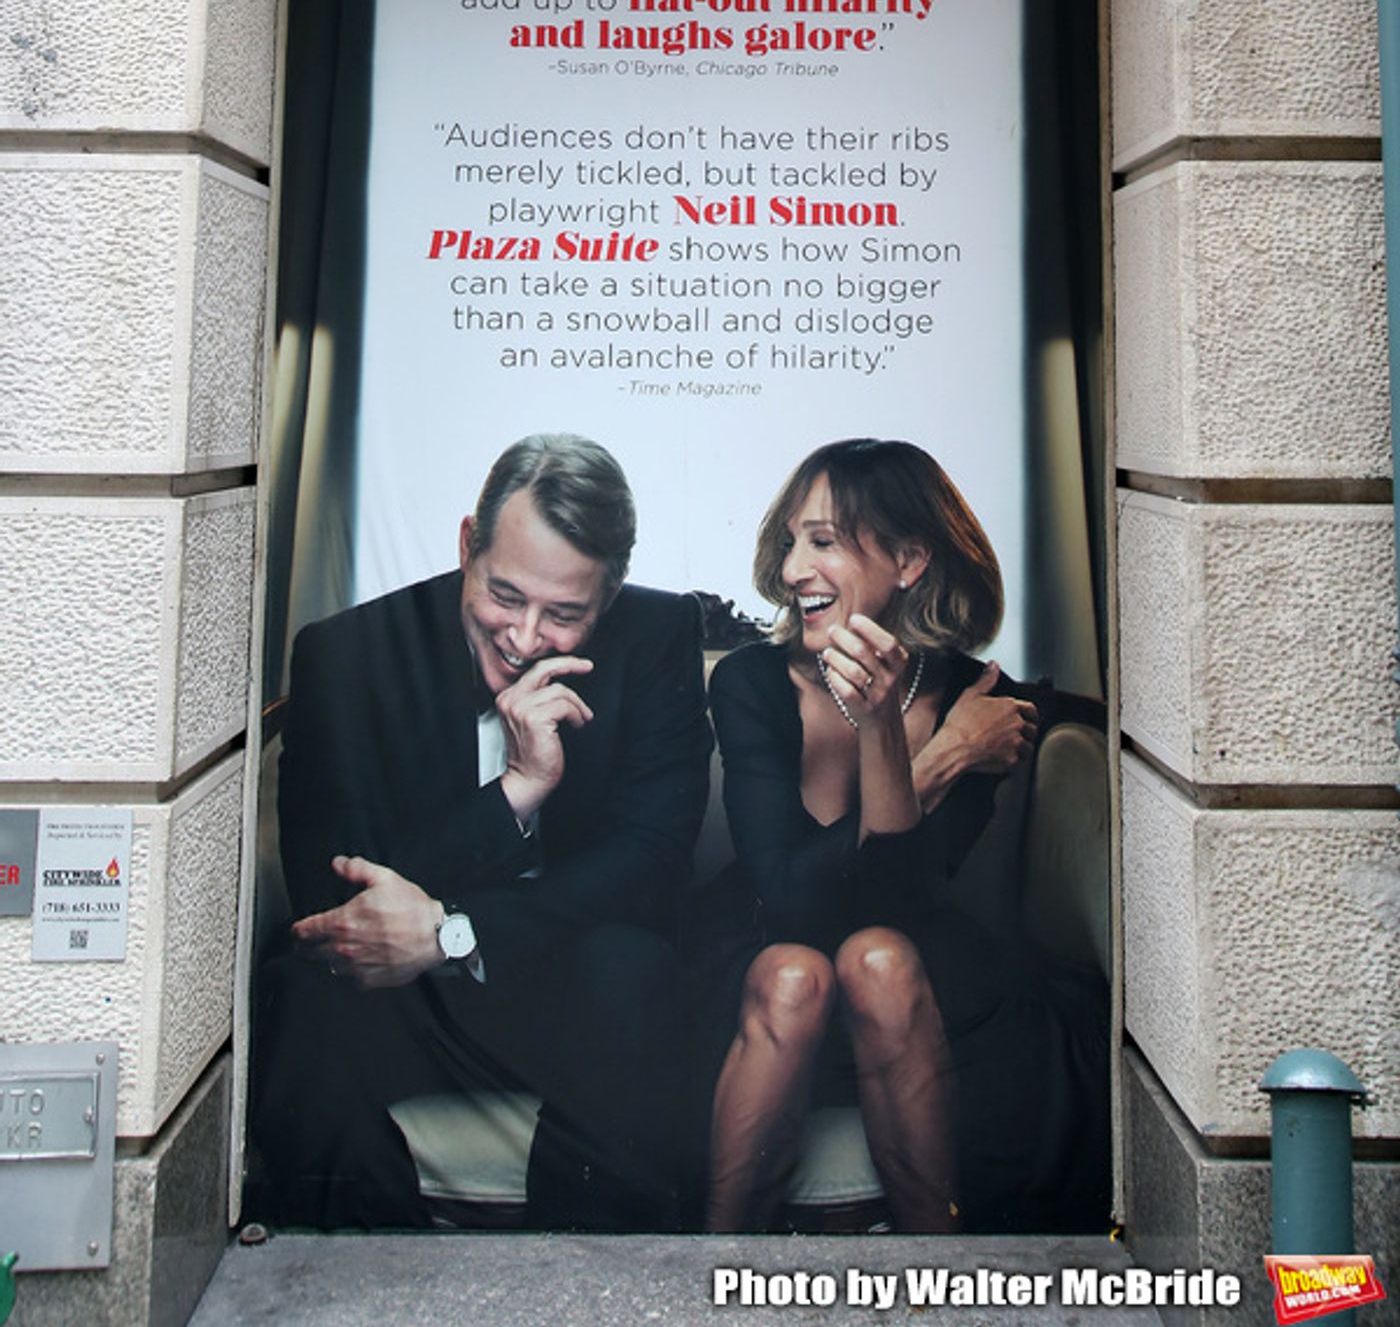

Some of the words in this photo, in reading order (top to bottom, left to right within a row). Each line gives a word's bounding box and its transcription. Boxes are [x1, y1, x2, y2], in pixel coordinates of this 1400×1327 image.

[509, 19, 585, 49] and
[598, 19, 734, 56] laughs
[744, 21, 895, 57] galore.”
[695, 60, 769, 80] Chicago
[775, 61, 840, 78] Tribune
[434, 122, 613, 150] “Audiences
[624, 124, 708, 151] don’t
[720, 124, 795, 152] have
[806, 125, 880, 152] their
[891, 126, 950, 153] ribs
[454, 158, 564, 190] merely
[576, 159, 691, 188] tickled,
[704, 160, 757, 187] but
[769, 161, 887, 188] tackled
[900, 161, 938, 192] by
[488, 197, 660, 229] playwright
[673, 195, 756, 226] Neil
[769, 195, 905, 227] Simon.
[424, 229, 541, 261] Plaza
[552, 231, 660, 262] Suite
[668, 235, 769, 262] shows
[781, 236, 849, 263] how
[860, 237, 961, 264] Simon
[450, 274, 508, 296] can
[520, 270, 590, 297] take
[599, 277, 618, 297] a
[630, 271, 772, 299] situation
[783, 278, 824, 299] no
[837, 272, 942, 304] bigger
[452, 305, 524, 332] than
[536, 311, 554, 332] a
[566, 306, 709, 334] snowball
[721, 307, 782, 334] and
[794, 307, 934, 339] dislodge
[499, 347, 538, 369] an
[550, 342, 714, 370] avalanche
[725, 342, 760, 370] of
[770, 343, 895, 376] hilarity.”
[676, 380, 763, 399] Magazine
[43, 869, 104, 880] CITYWIDE
